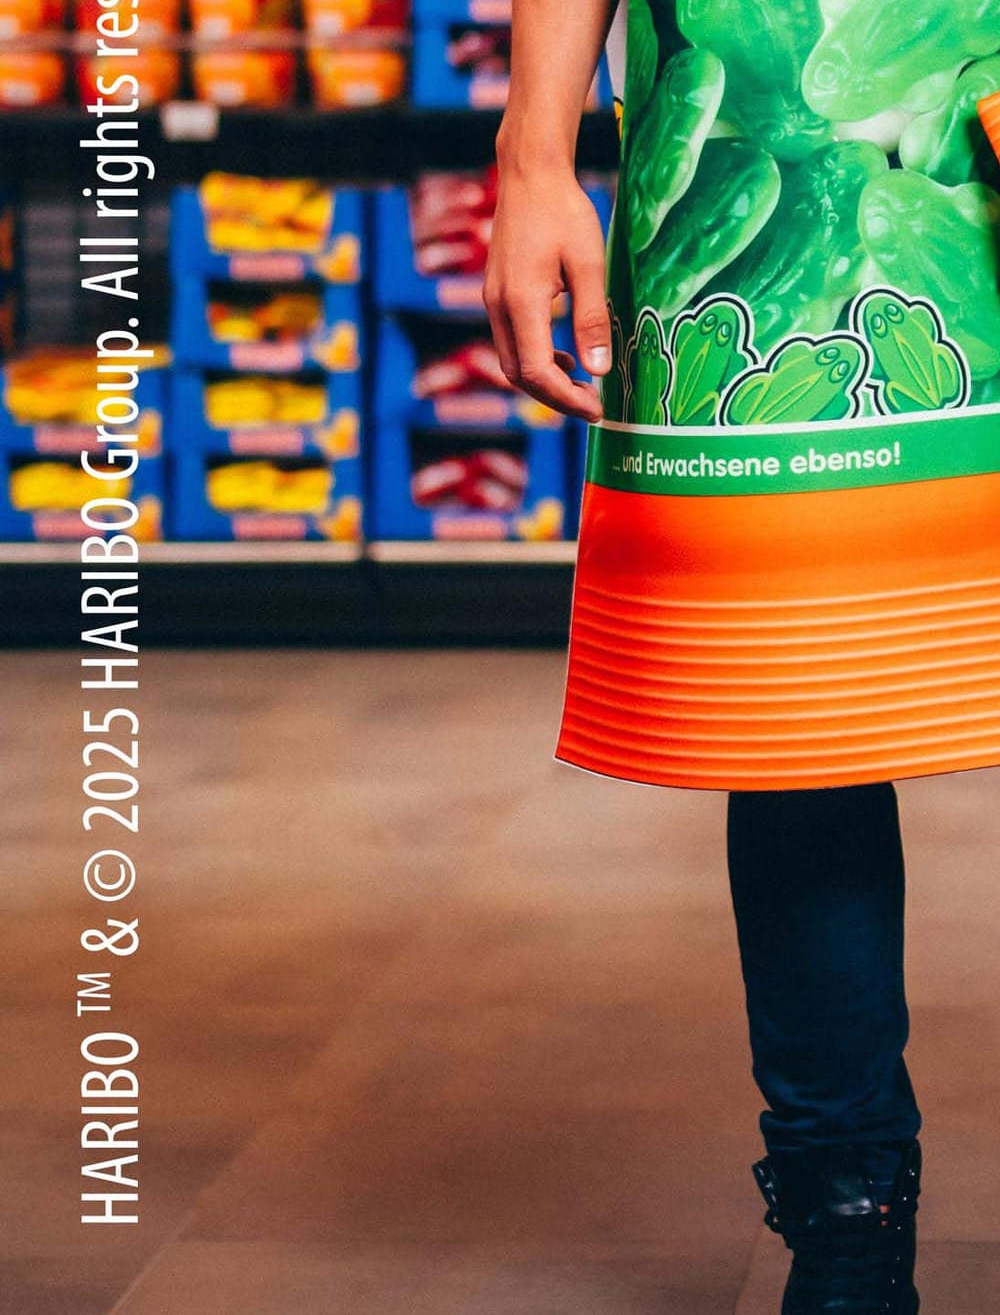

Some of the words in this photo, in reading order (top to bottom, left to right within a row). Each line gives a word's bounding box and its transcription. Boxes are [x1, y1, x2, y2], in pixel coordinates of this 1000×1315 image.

[622, 450, 643, 474] und
[646, 452, 780, 477] Erwachsene
[789, 441, 900, 474] ebenso!
